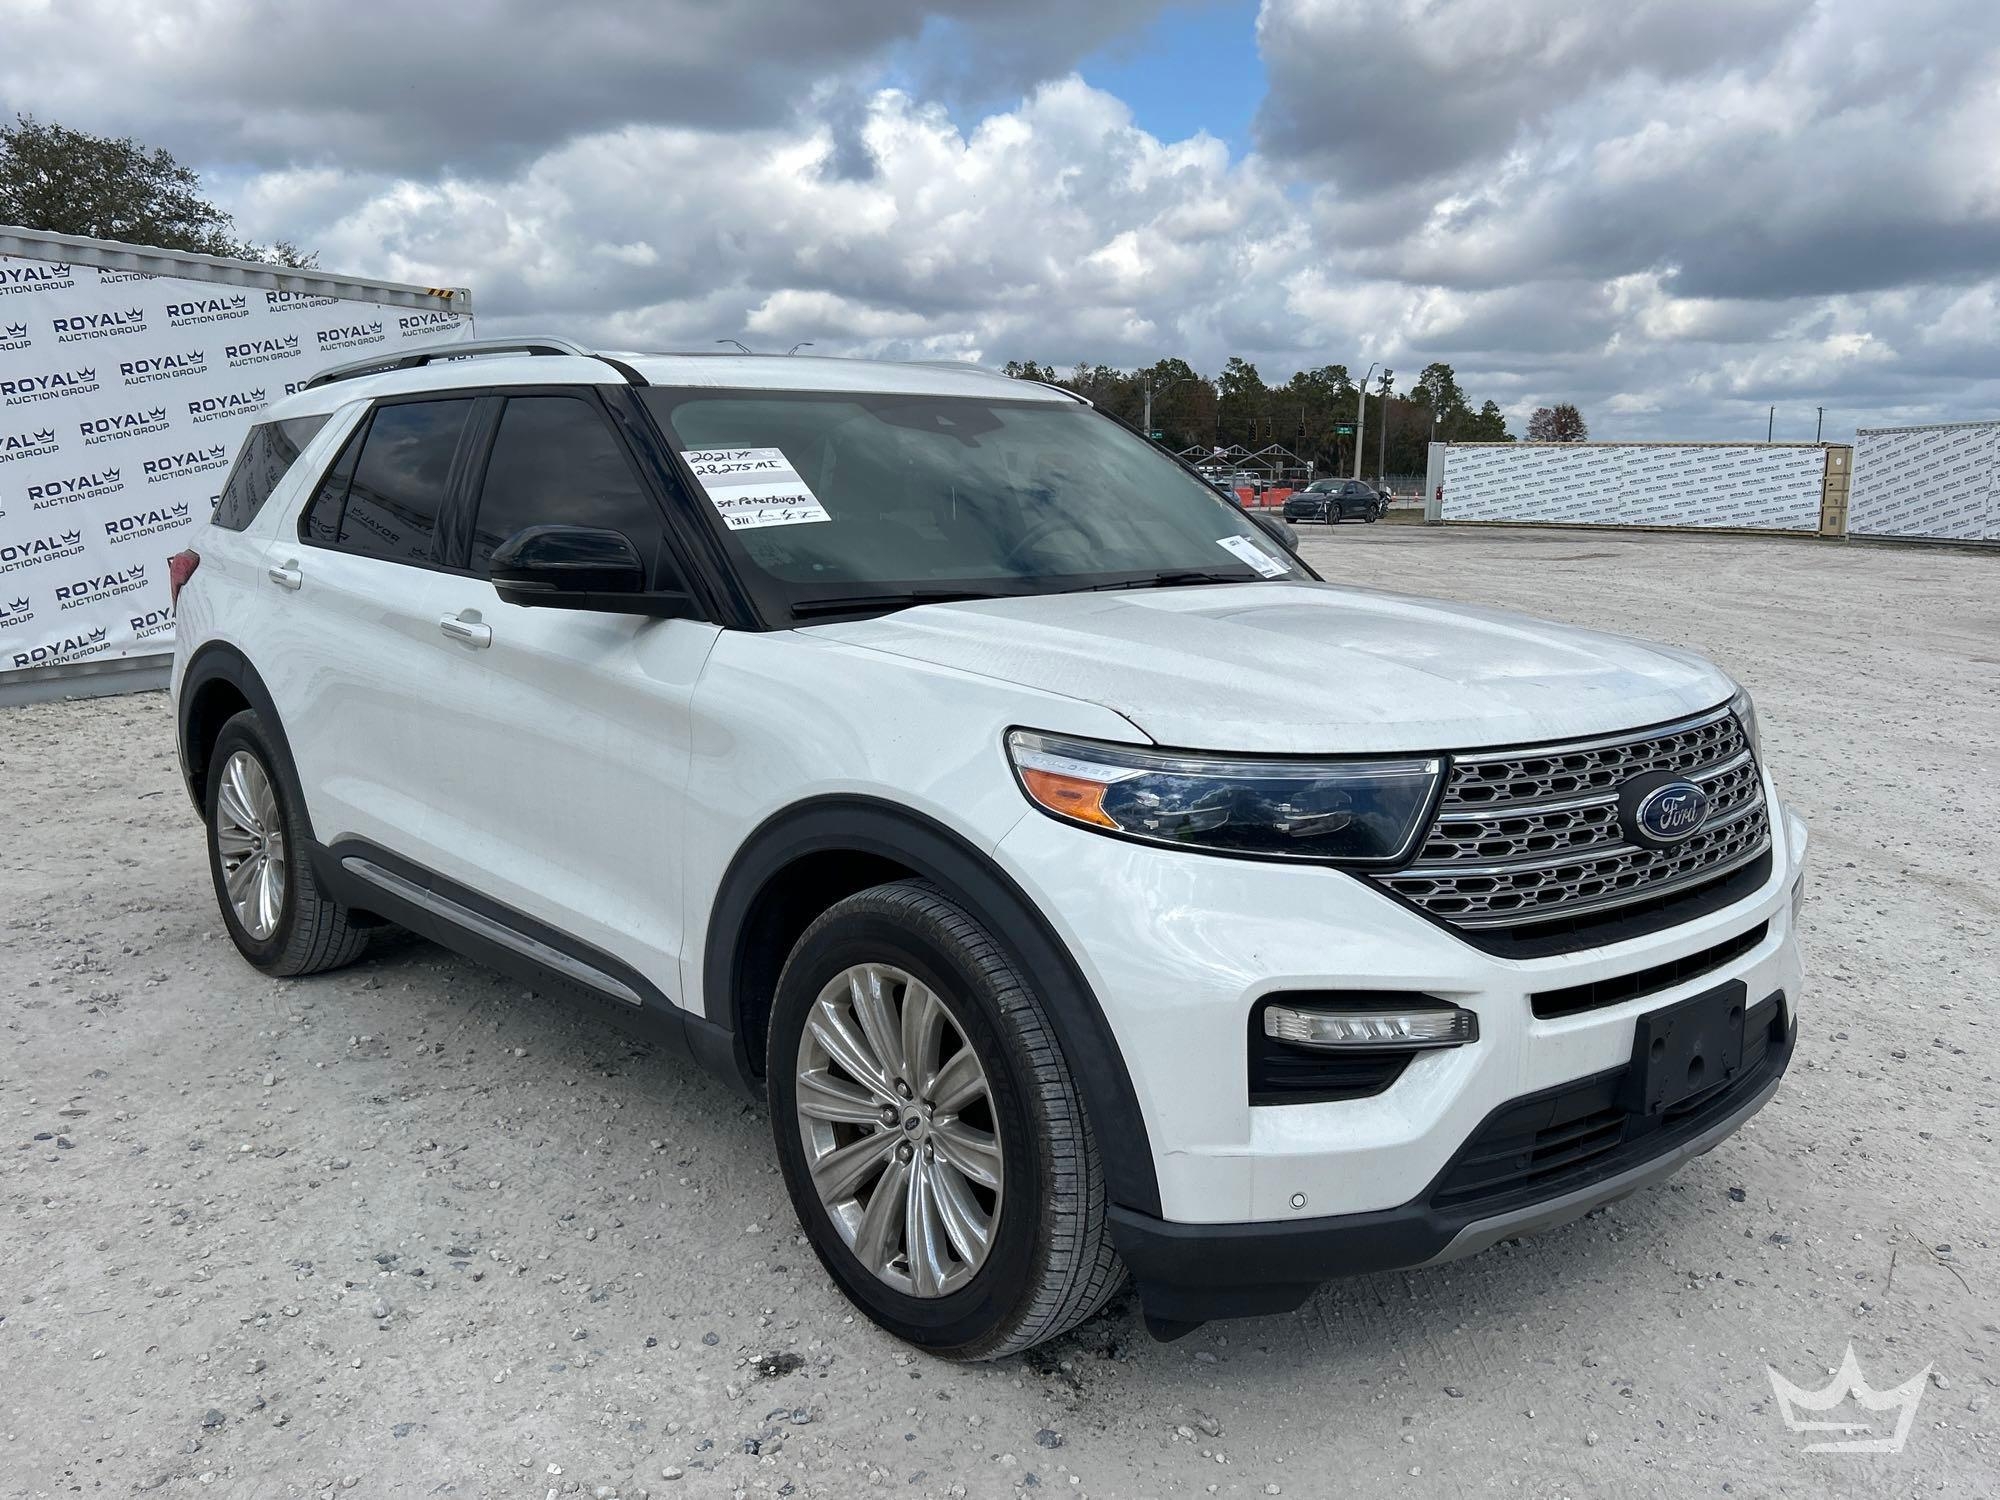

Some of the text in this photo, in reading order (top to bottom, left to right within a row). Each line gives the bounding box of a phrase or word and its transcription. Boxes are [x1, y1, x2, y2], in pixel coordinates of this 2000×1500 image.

[34, 280, 75, 292] GROUP
[100, 273, 149, 284] AUCTION
[166, 298, 232, 318] ROYAL
[269, 297, 339, 313] AUCTION GROUP
[53, 312, 126, 333] ROYAL
[170, 310, 249, 328] AUCTION GROUP
[399, 313, 447, 330] ROYAL
[58, 324, 147, 343] AUCTION GROUP
[317, 324, 370, 343] ROYAL
[402, 322, 461, 338] AUCTION GROUP
[225, 338, 285, 359] ROYAL
[320, 335, 385, 352] AUCTION GROUP
[120, 354, 188, 376] ROYAL
[229, 349, 301, 368] AUCTION GROUP
[0, 371, 79, 395] ROYAL
[124, 365, 208, 386] AUCTION GROUP
[5, 384, 100, 406] AUCTION GROUP
[188, 393, 251, 414] ROYAL
[80, 411, 149, 436] ROYAL
[192, 409, 236, 424] AUCTION
[85, 423, 170, 446] AUCTION GROUP
[16, 445, 60, 460] GROUP
[143, 449, 209, 474] ROYAL
[690, 452, 731, 463] 2021
[147, 459, 229, 484] AUCTION GROUP
[695, 463, 753, 475] 28,275
[28, 473, 103, 500] ROYAL
[33, 483, 124, 510] AUCTION GROUP
[105, 508, 172, 535] ROYAL
[109, 517, 192, 545] AUCTION GROUP
[44, 545, 85, 562] GROUP
[56, 572, 129, 601] ROYAL
[60, 579, 149, 611] AUCTION GROUP
[130, 607, 176, 630] ROY
[13, 635, 89, 668] ROYAL
[72, 642, 111, 660] GROUP
[1660, 795, 1698, 829] Ford
